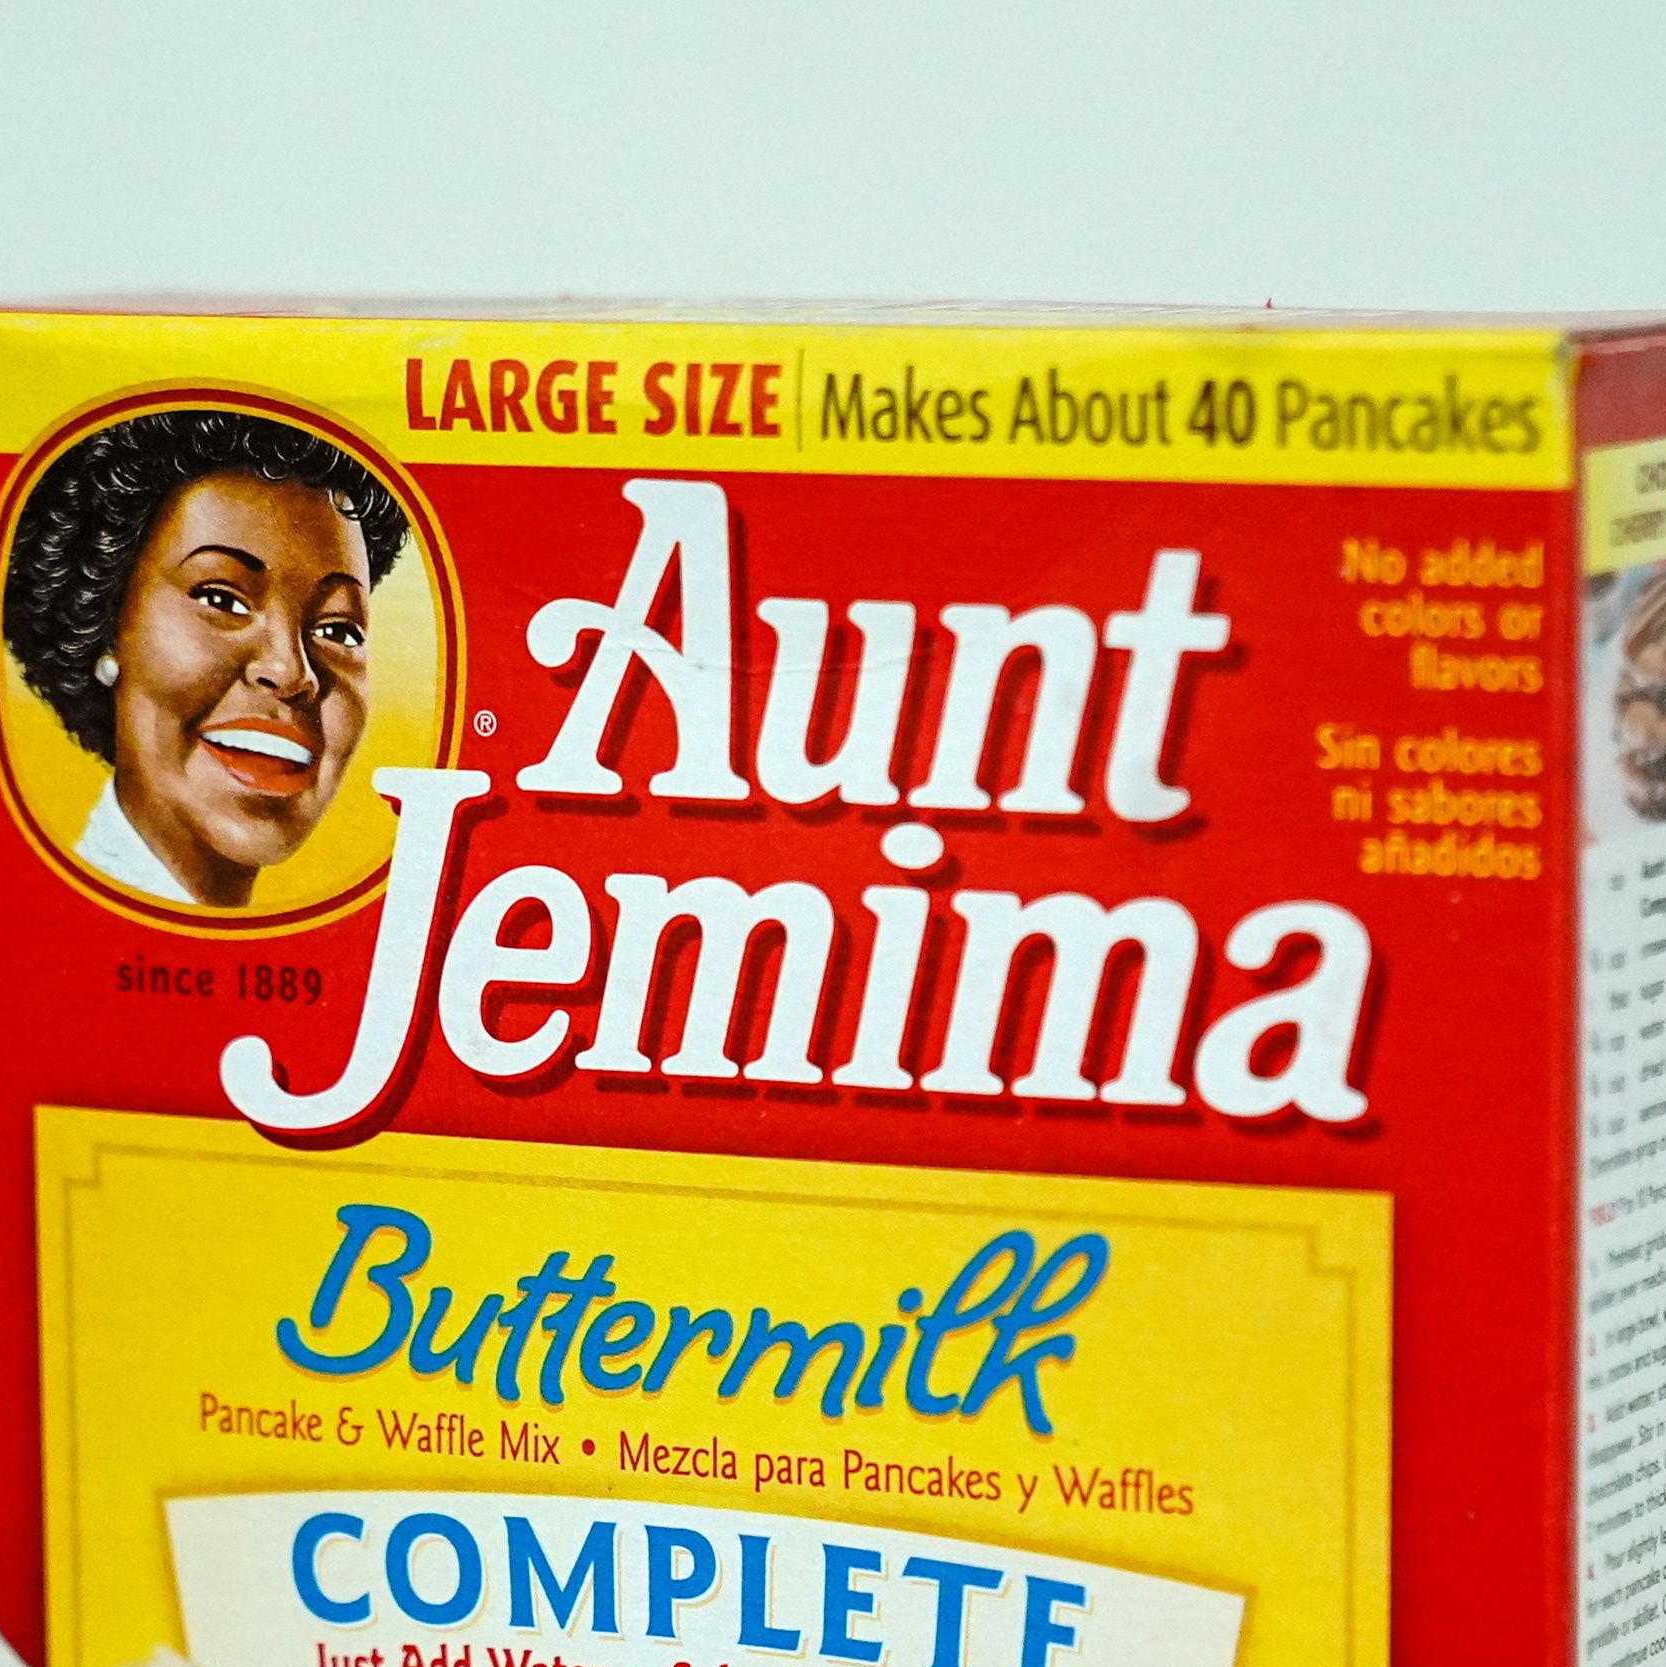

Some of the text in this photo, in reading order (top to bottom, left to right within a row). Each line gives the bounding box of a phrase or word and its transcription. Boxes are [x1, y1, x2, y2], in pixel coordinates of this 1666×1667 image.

[406, 358, 1541, 453] LARGE SIZE Makes About 40 Pancakes
[1341, 536, 1545, 588] No added
[1359, 590, 1542, 640] colors or
[516, 478, 1231, 822] Aunt
[1409, 640, 1544, 693] flavors
[1315, 722, 1543, 776] Sin colores
[1332, 777, 1542, 828] ni sabores
[1359, 829, 1541, 880] añadidos
[220, 766, 1372, 1129] Jemima
[116, 961, 323, 1004] since 1889
[277, 1204, 1110, 1436] Buttermilk
[199, 1393, 1194, 1515] Pancake & Waffle Mix Mezcla para Pancakes y Waffles
